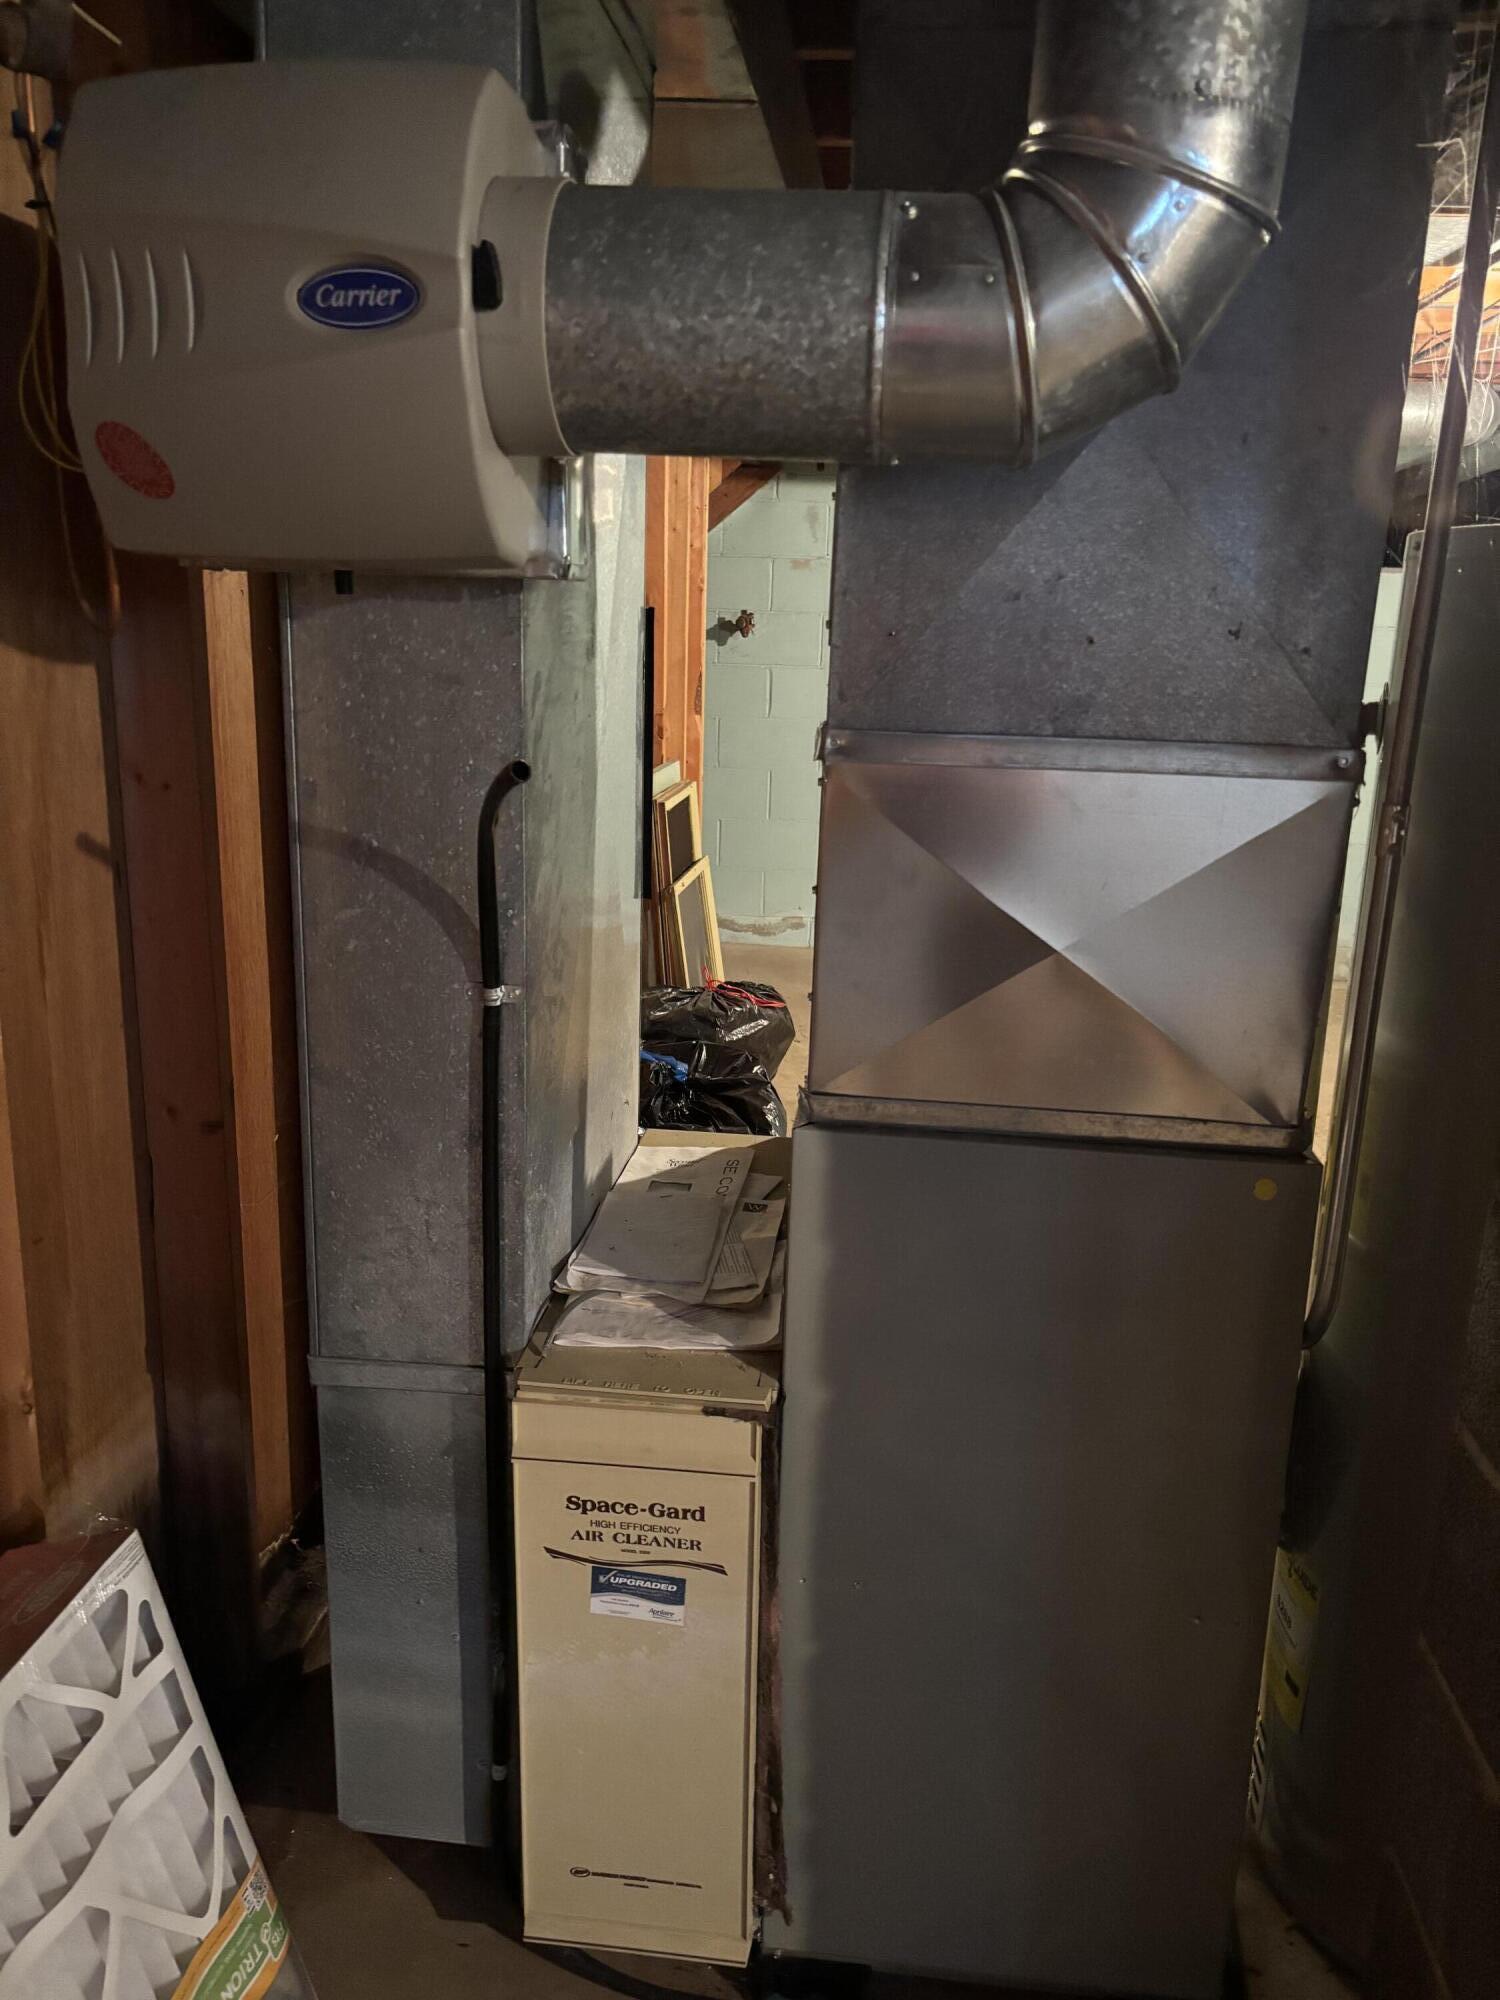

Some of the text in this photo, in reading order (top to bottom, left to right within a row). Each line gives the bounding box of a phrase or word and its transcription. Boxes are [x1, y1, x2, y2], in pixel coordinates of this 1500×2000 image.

[315, 284, 402, 308] Carrier
[716, 1159, 740, 1197] SECO
[565, 1495, 706, 1522] Space-Gard
[590, 1519, 681, 1535] HIGH EFFICIENCY
[571, 1529, 702, 1552] AIR CLEANER
[610, 1576, 678, 1592] UPGRADED
[220, 1943, 264, 2000] TRION
